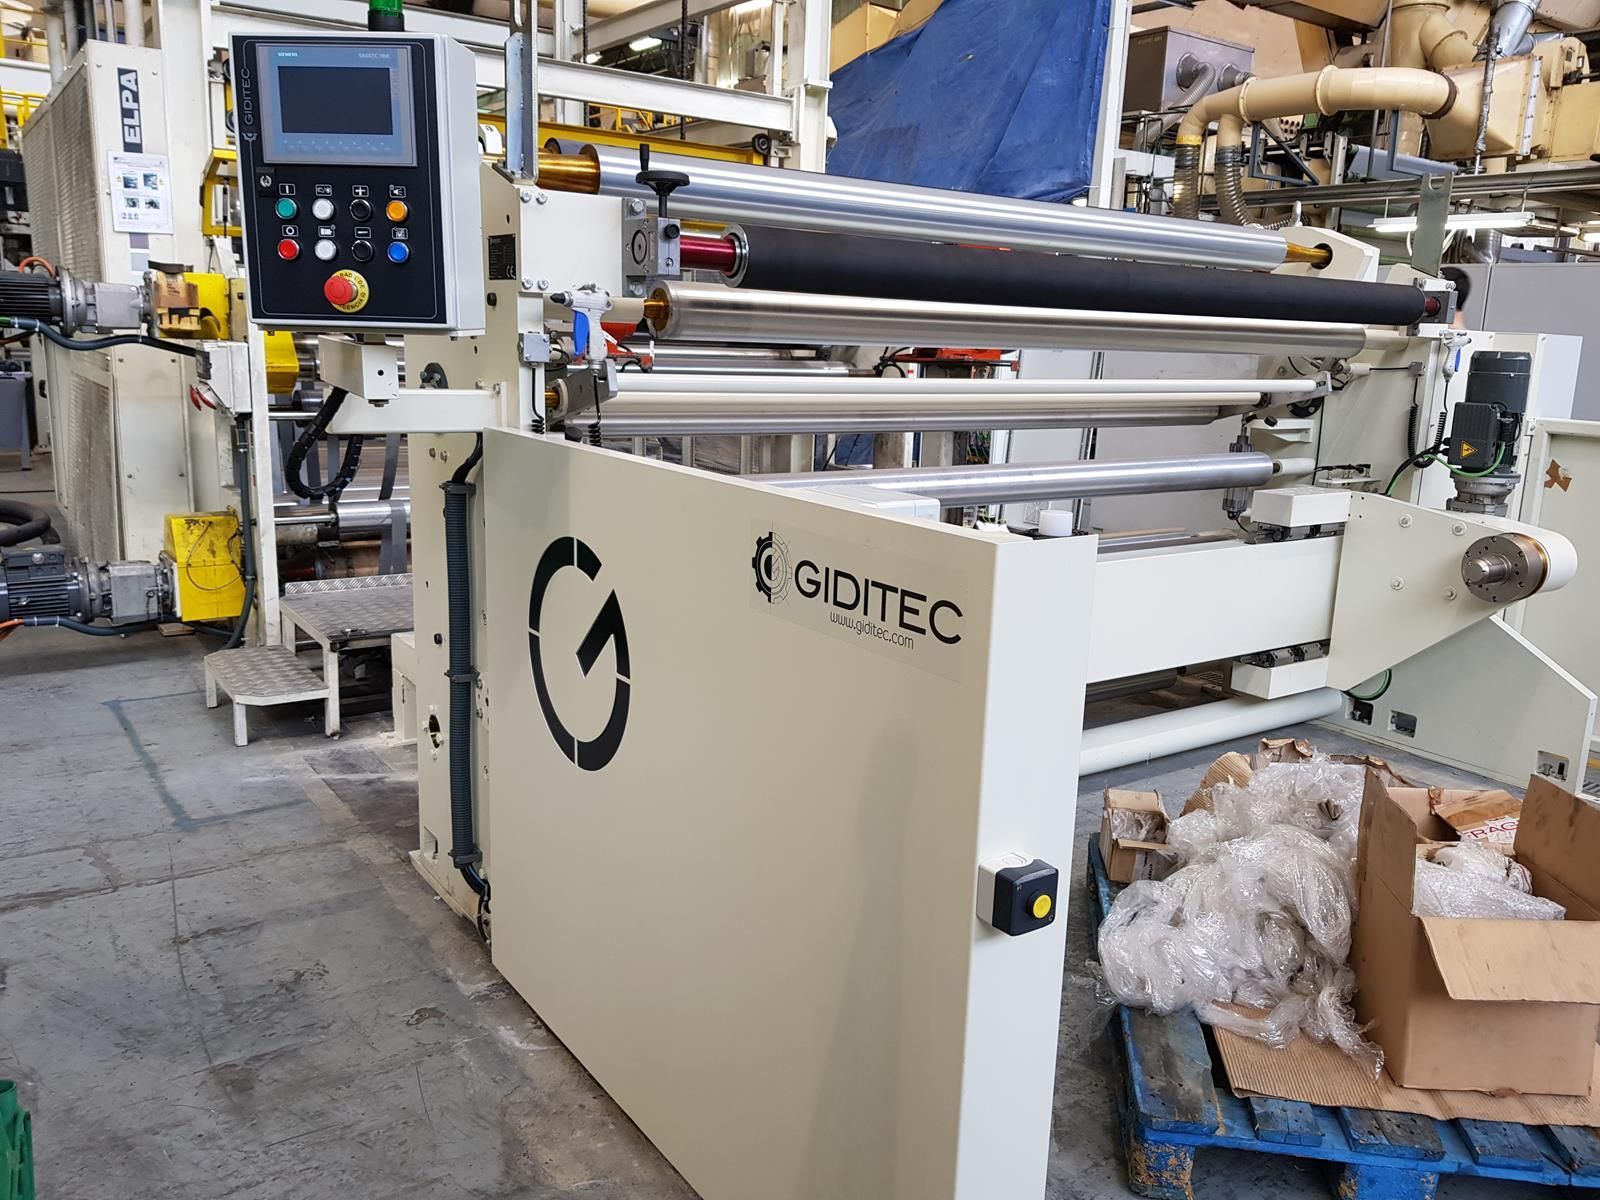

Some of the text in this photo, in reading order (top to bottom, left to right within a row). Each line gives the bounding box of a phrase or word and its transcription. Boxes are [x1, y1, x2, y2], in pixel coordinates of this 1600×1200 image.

[120, 71, 142, 144] ELPA
[241, 68, 253, 125] GIDITEC
[794, 559, 963, 645] GIDITEC
[830, 610, 914, 650] www.giditec.com
